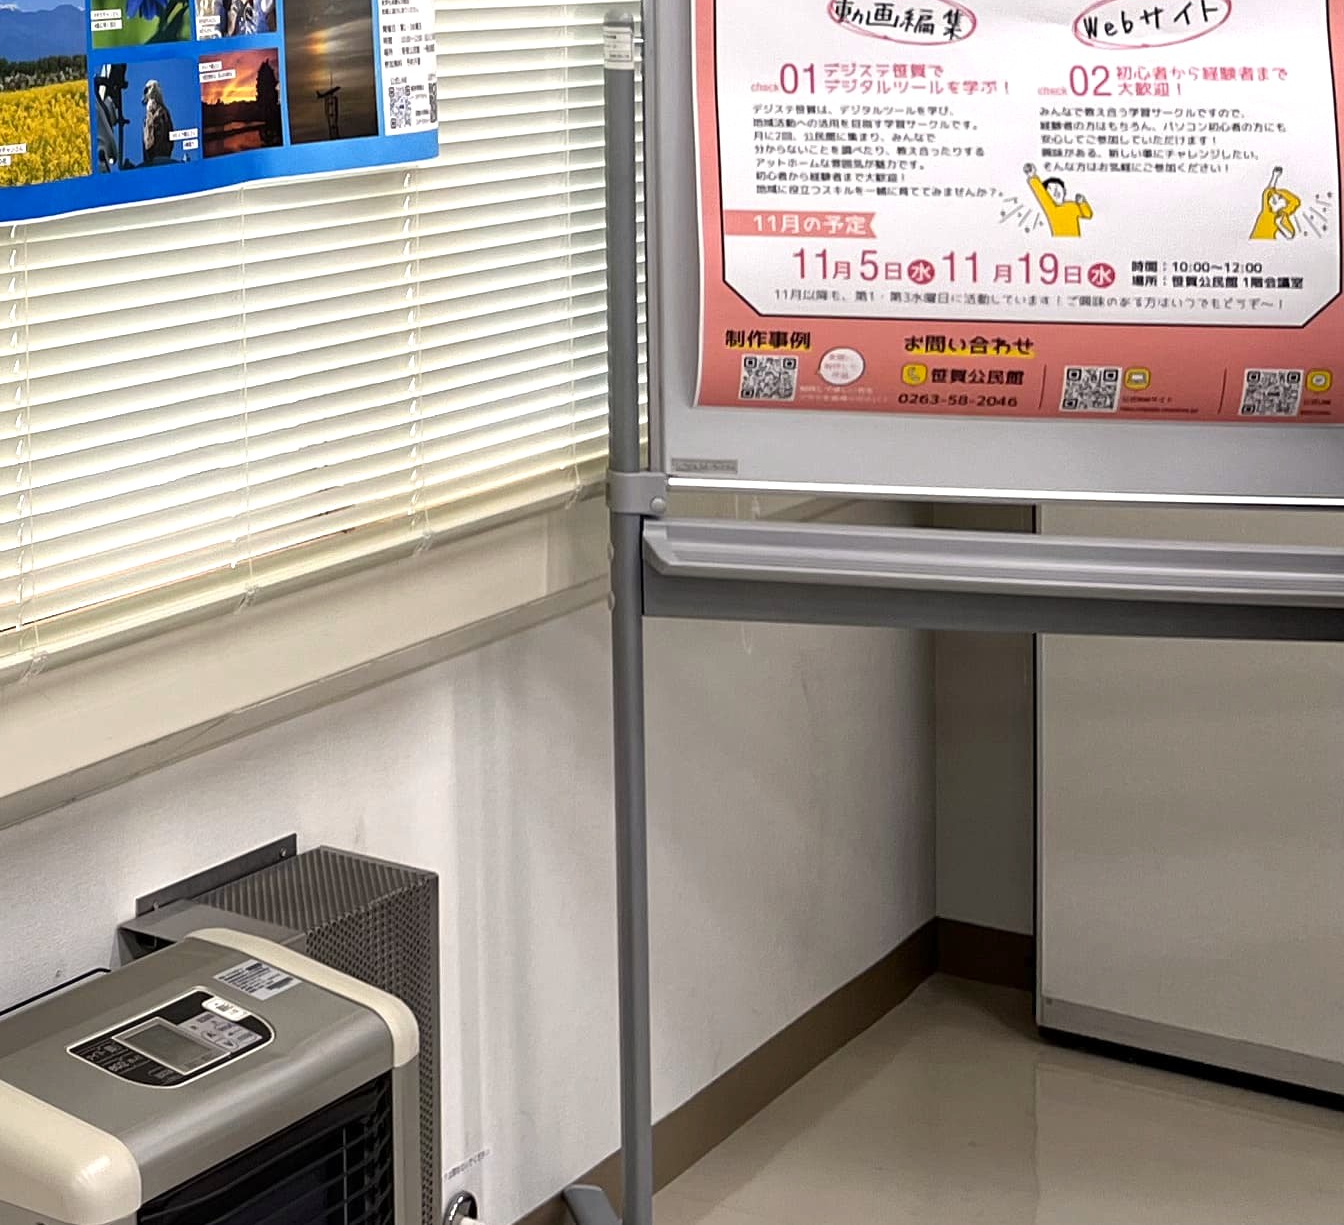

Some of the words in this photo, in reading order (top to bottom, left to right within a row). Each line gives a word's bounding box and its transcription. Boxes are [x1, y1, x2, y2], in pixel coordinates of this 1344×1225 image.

[779, 62, 816, 95] 01
[823, 63, 944, 79] デジステ笹賀で
[1116, 65, 1289, 82] 初心者から経験者まで
[823, 79, 1010, 96] デジタルツールを学ぶ！
[1069, 65, 1113, 97] 02
[1117, 82, 1183, 97] 大歓迎！
[752, 213, 867, 236] 11月の予定
[724, 329, 811, 350] 制作事例
[903, 334, 1035, 356] お問い合わせ
[931, 368, 1025, 385] 笹賀公民館
[897, 392, 1018, 409] 0263-58-2046
